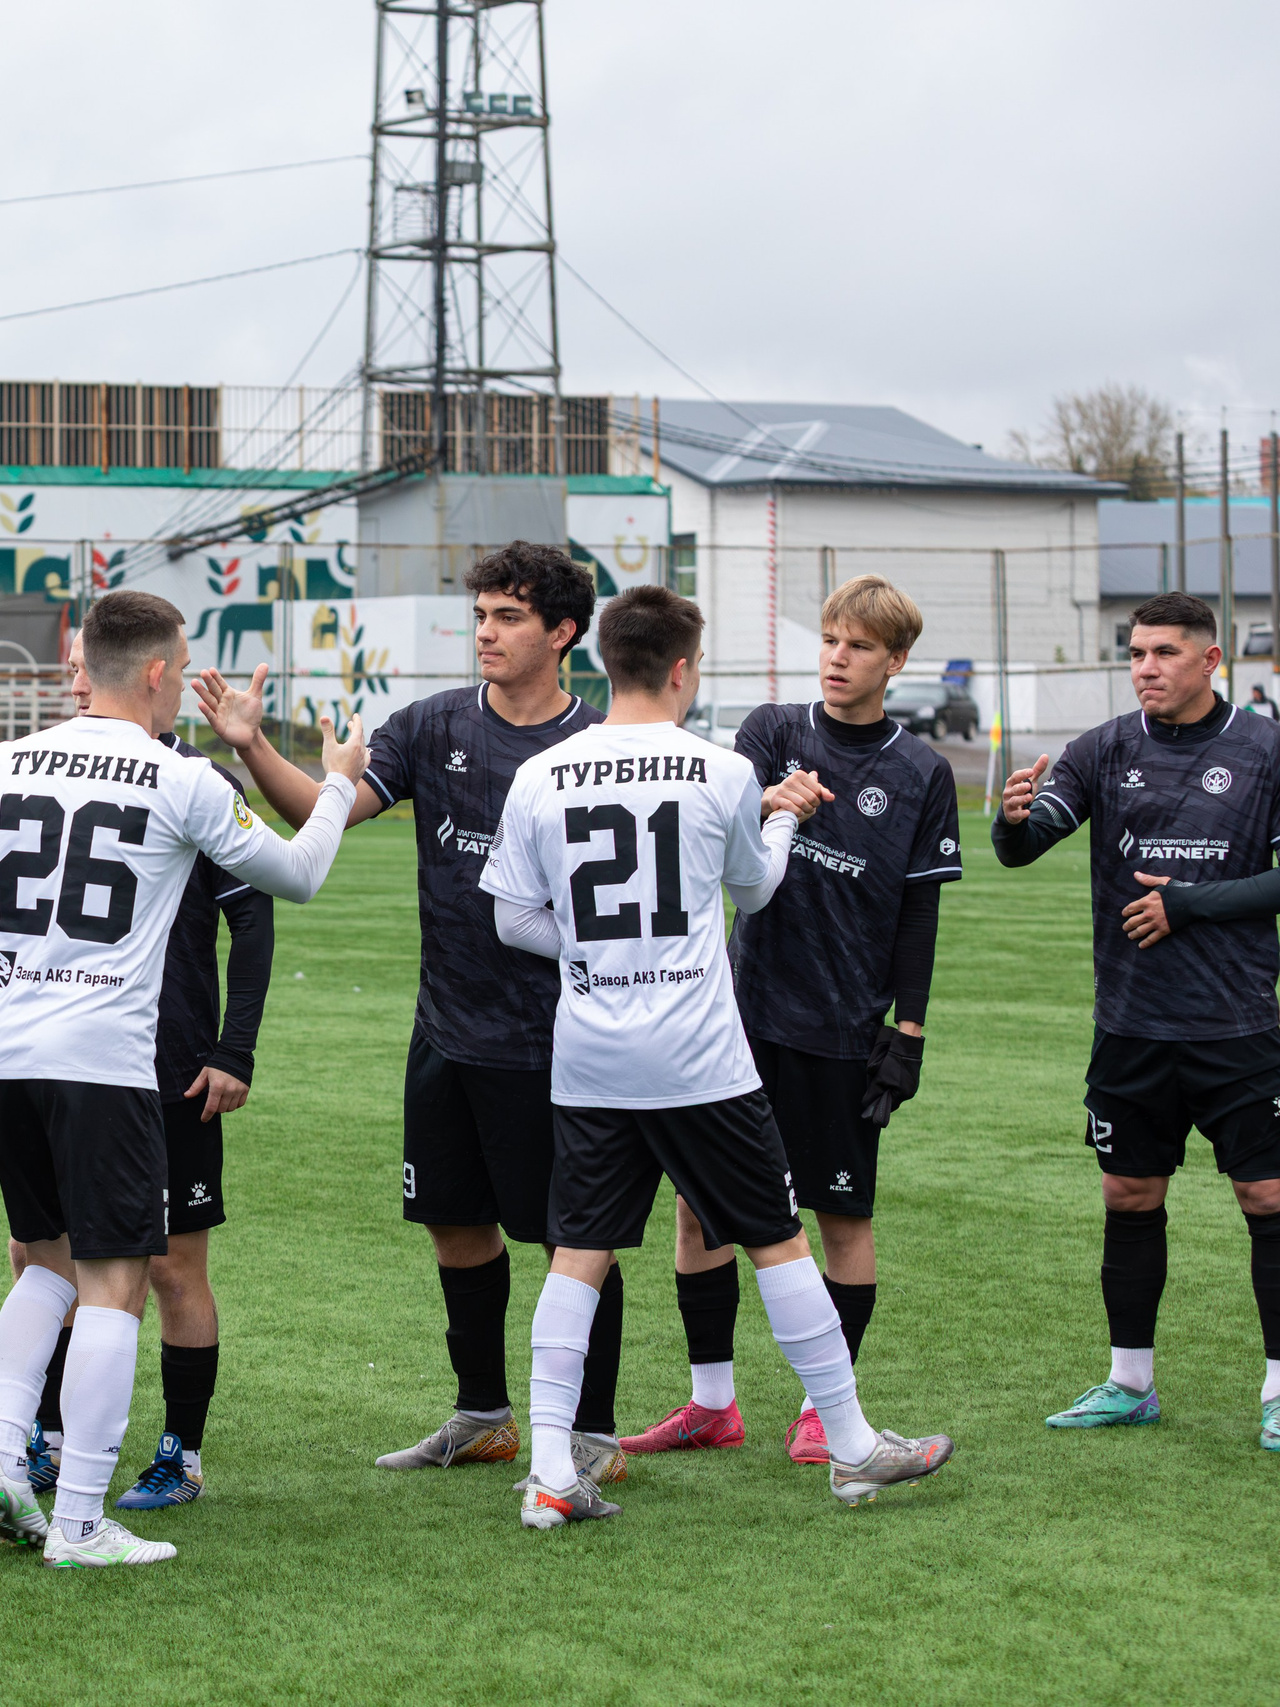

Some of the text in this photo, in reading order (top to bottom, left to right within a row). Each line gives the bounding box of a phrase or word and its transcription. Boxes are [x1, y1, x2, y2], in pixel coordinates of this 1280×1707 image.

[11, 750, 160, 789] ТУРБИНА
[551, 756, 707, 790] ТУРБИНА
[1139, 838, 1230, 848] БЛАГОТВОРИТЕЛЬНЫЙ ФОНД
[846, 854, 867, 867] ФОНД
[1139, 846, 1229, 860] TATNEFT
[565, 801, 688, 942] 21
[76, 970, 125, 987] Гарант
[592, 973, 630, 988] Завод
[659, 967, 705, 984] Гарант
[829, 1184, 853, 1192] KELME
[187, 1195, 213, 1207] KELME
